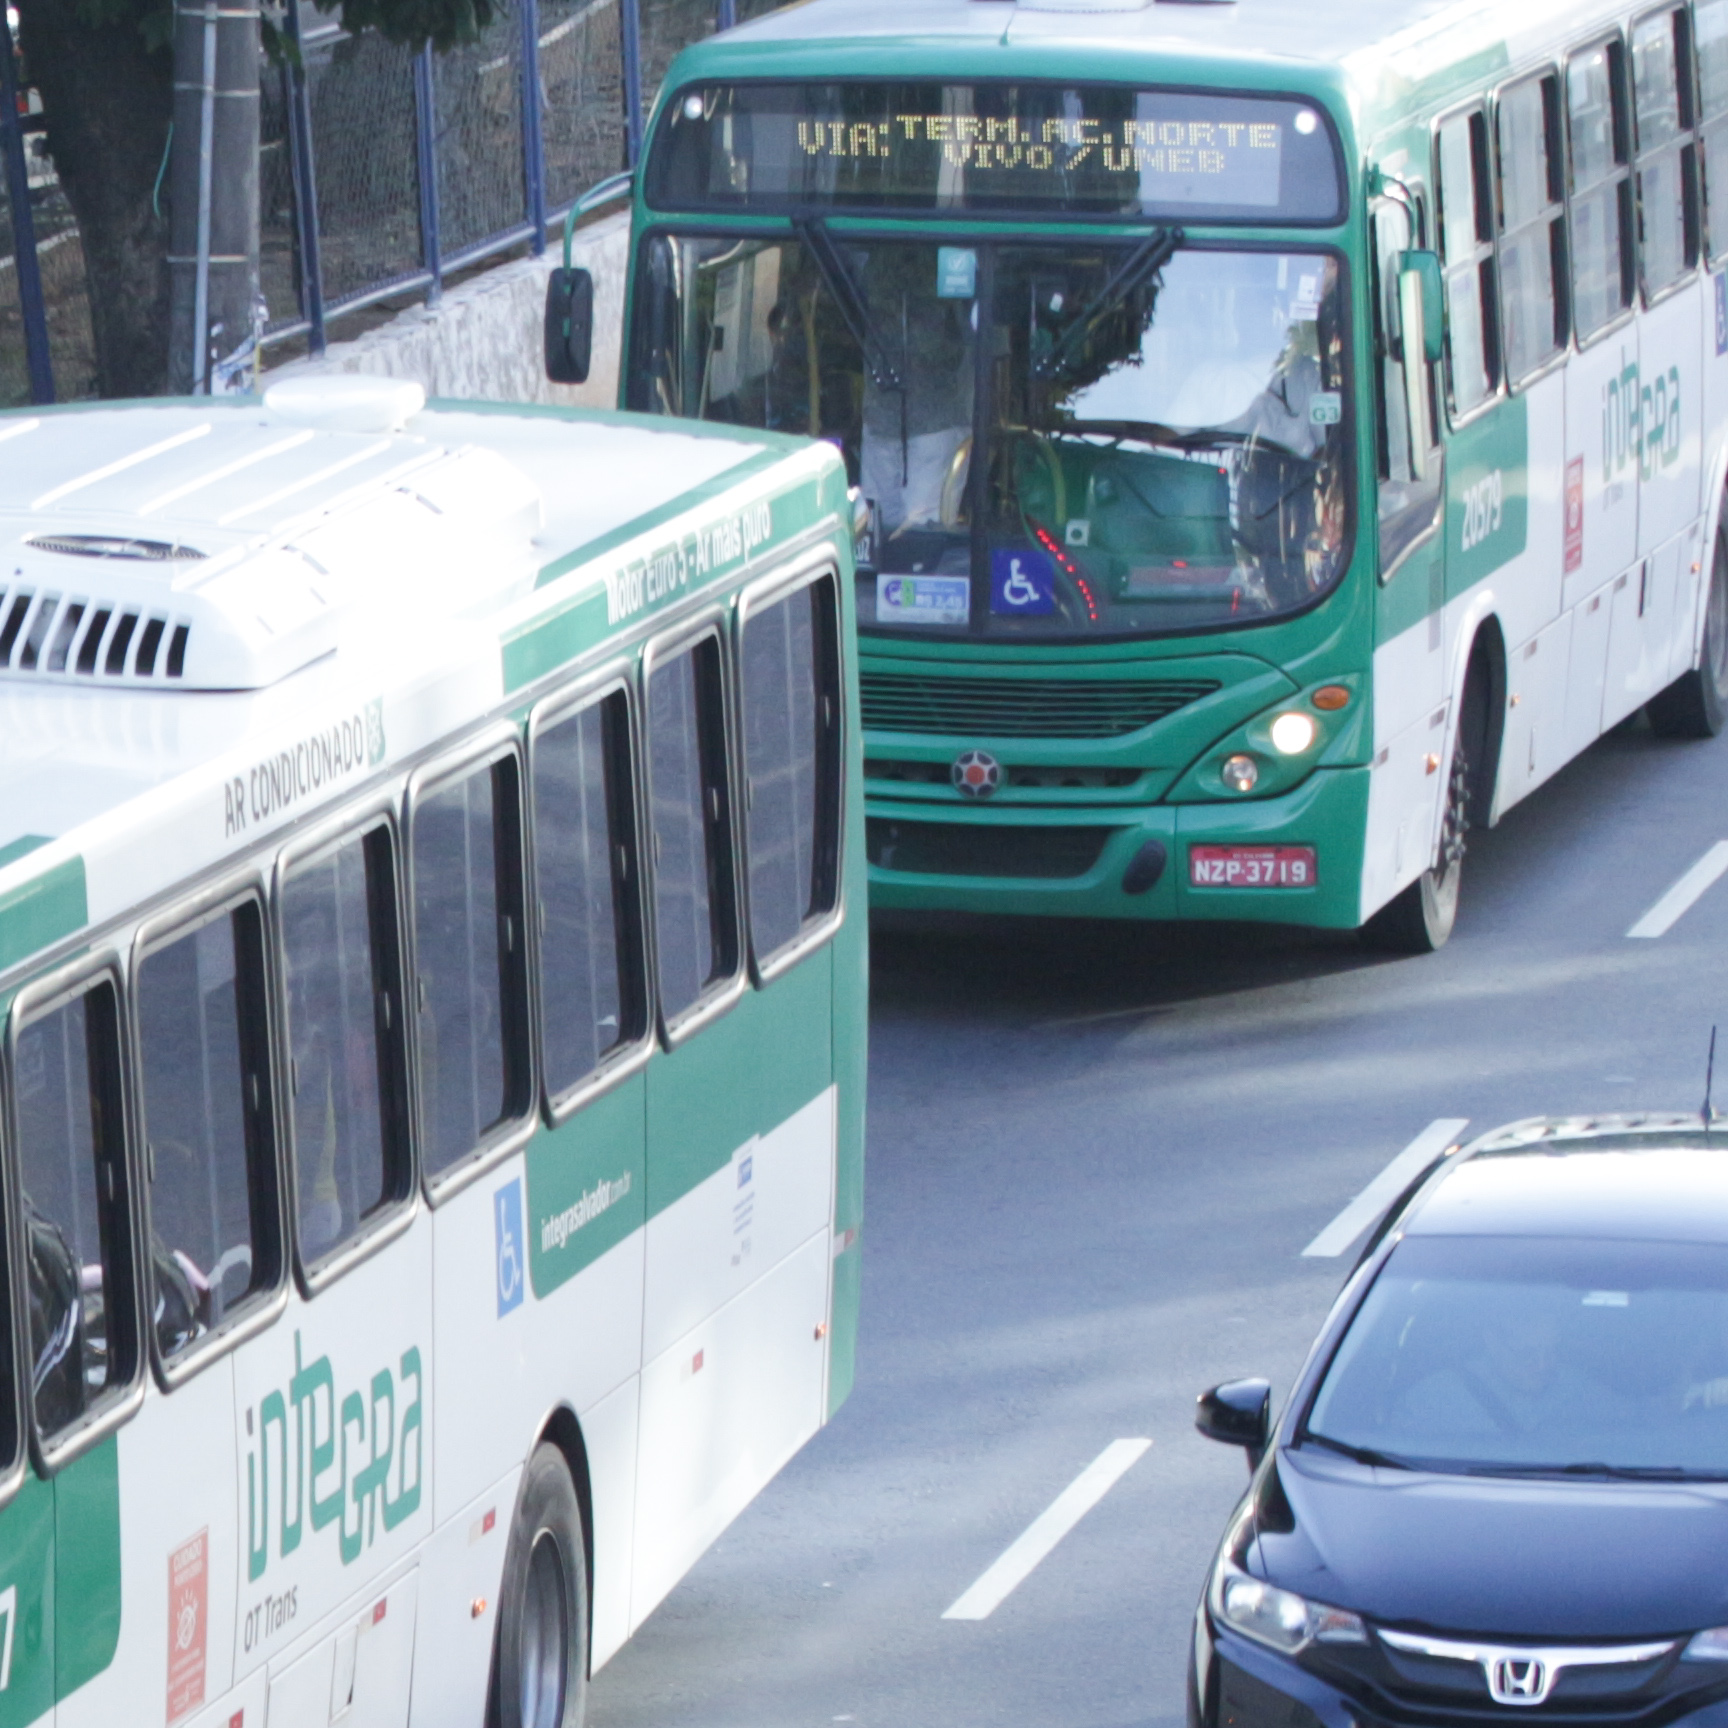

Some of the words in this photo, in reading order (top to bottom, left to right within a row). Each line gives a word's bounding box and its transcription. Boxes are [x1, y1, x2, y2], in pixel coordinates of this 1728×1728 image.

[798, 122, 889, 157] VIA:
[604, 568, 645, 627] Motor
[645, 551, 678, 603] Euro
[712, 515, 743, 568] mais
[742, 500, 773, 565] puro
[224, 776, 246, 840] AR
[249, 714, 364, 824] CONDICIONADO
[264, 1585, 299, 1639] Trans
